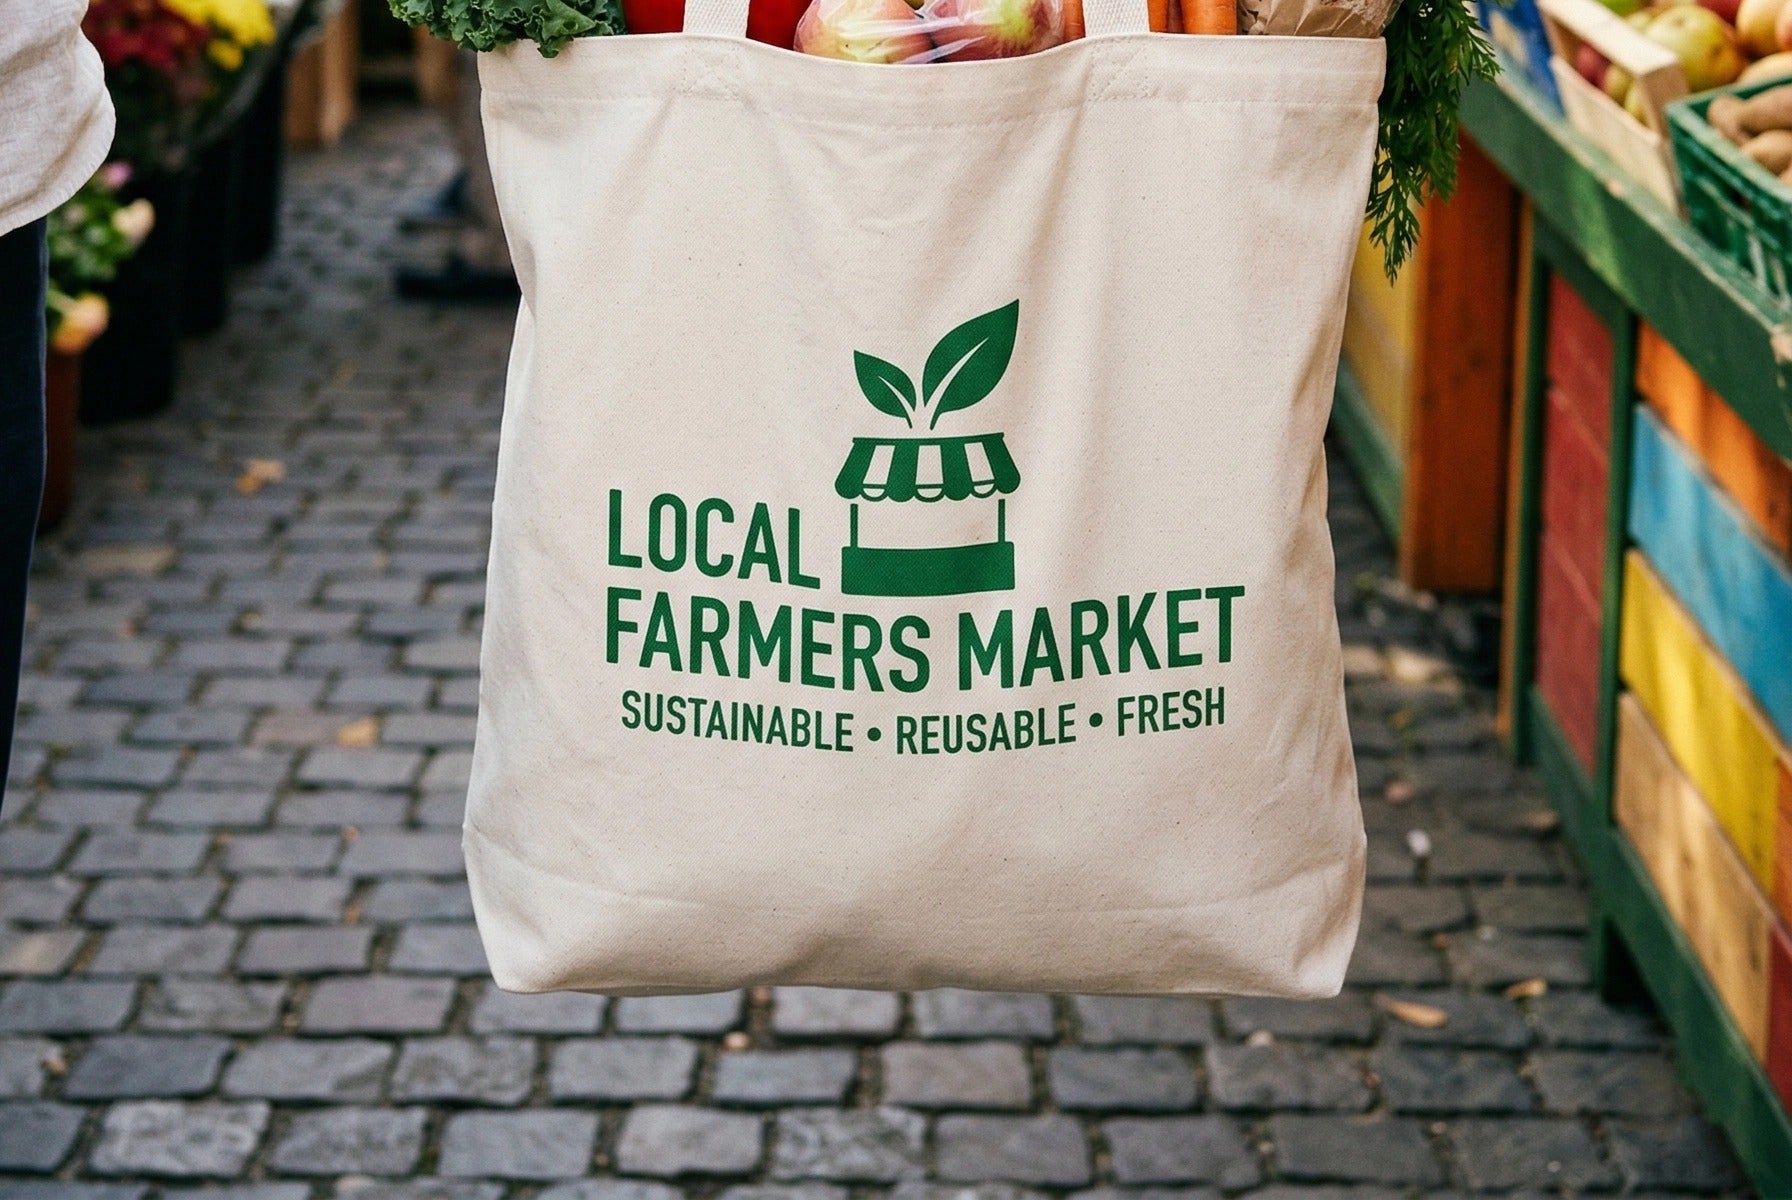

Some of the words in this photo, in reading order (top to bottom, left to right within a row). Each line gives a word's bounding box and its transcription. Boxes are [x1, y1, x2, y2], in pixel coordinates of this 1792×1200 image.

[607, 488, 821, 589] LOCAL
[606, 586, 931, 693] FARMERS
[958, 585, 1246, 691] MARKET
[621, 689, 855, 753] SUSTAINABLE
[896, 702, 1077, 755] REUSABLE
[1117, 686, 1226, 737] FRESH
